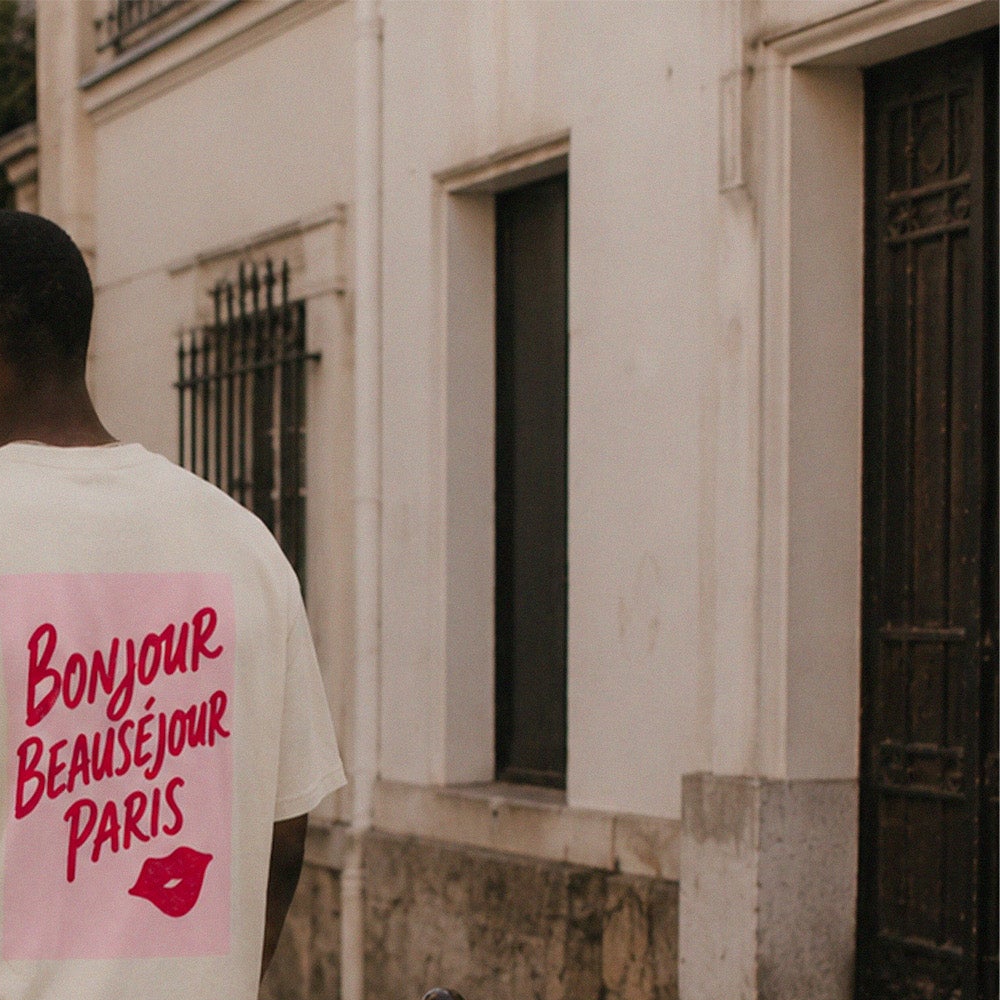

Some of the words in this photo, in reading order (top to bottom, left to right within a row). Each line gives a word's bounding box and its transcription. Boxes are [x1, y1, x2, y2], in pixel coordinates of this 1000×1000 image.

[25, 606, 224, 728] BONJOUR
[14, 689, 231, 820] BEAUSÉJOUR
[63, 776, 185, 883] PARIS
